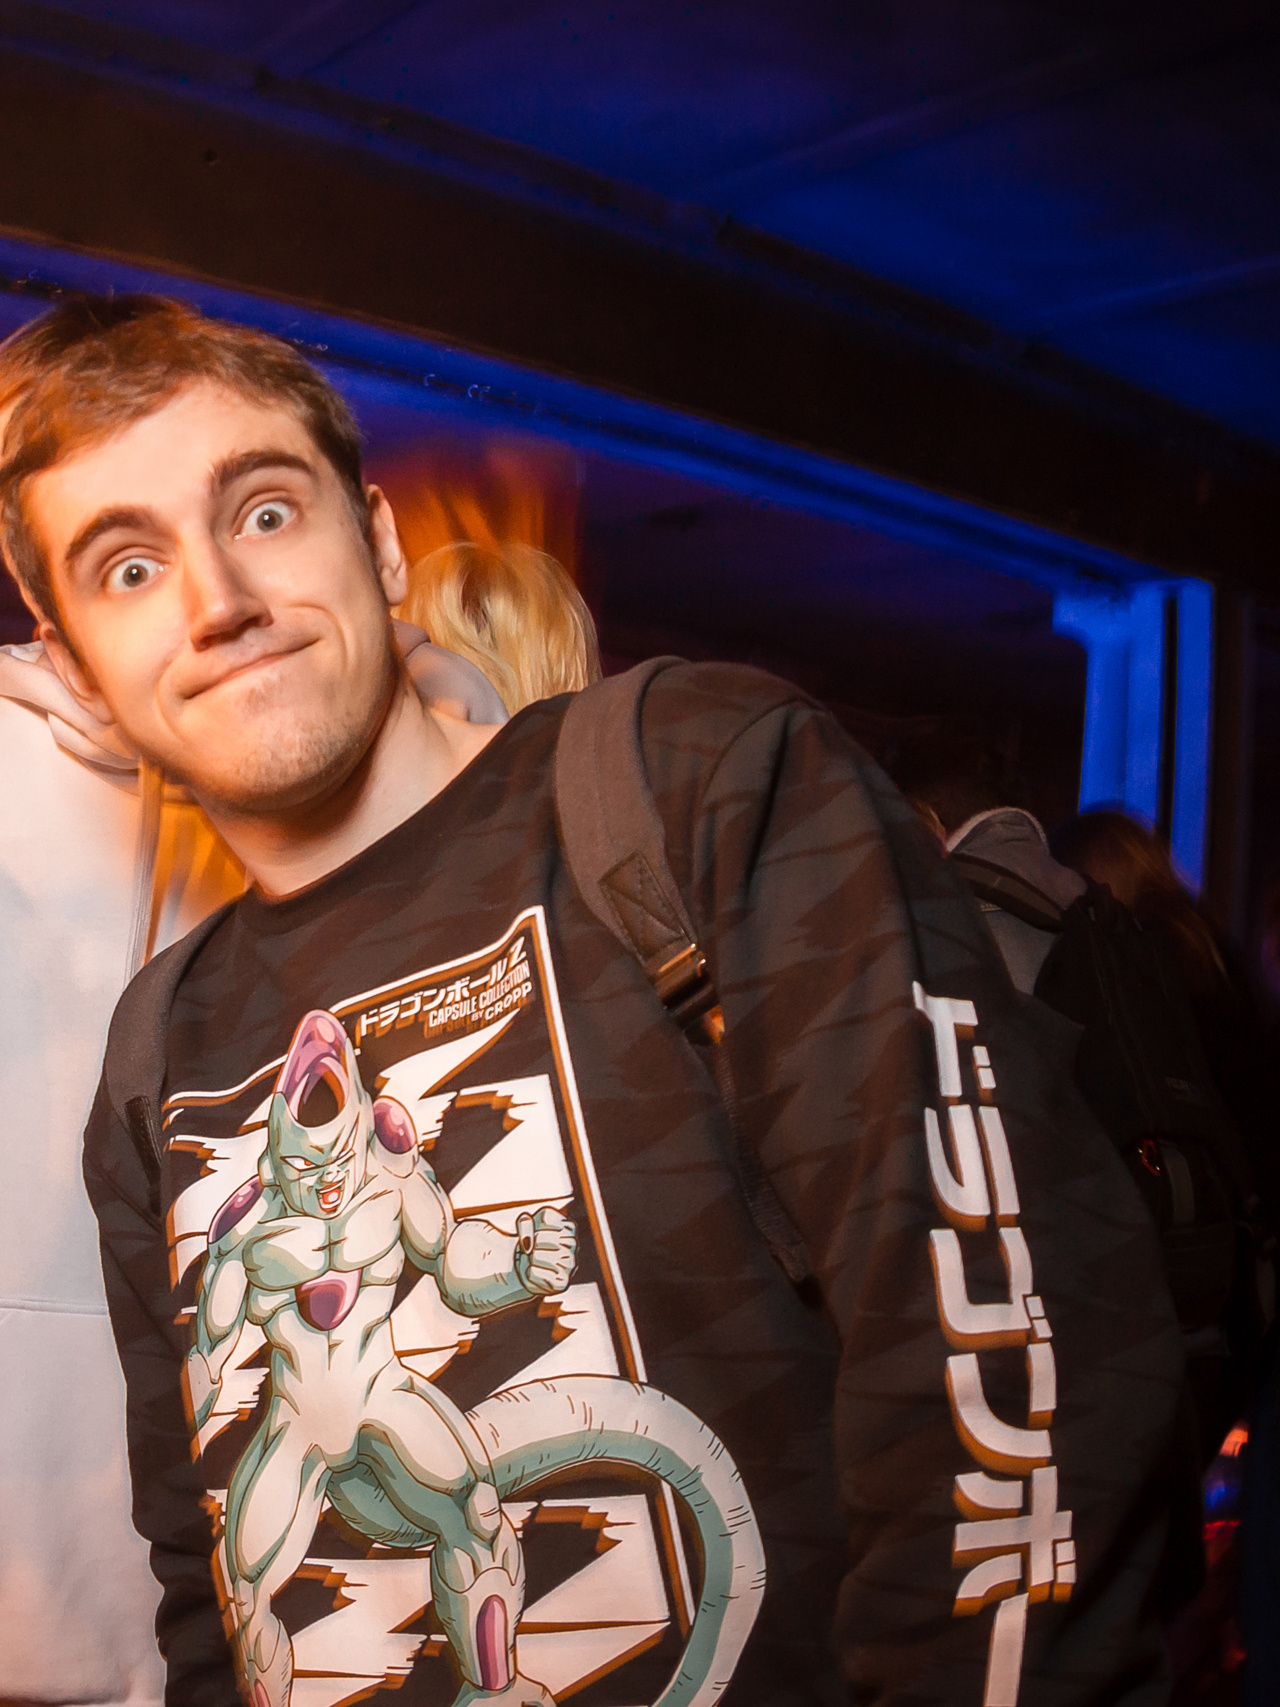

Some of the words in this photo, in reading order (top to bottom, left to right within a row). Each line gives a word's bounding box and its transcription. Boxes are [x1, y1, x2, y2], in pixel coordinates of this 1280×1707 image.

[428, 995, 478, 1028] CAPSULE
[478, 960, 531, 1008] COLLECTION
[470, 1009, 486, 1023] BY
[484, 981, 533, 1021] CROPP
